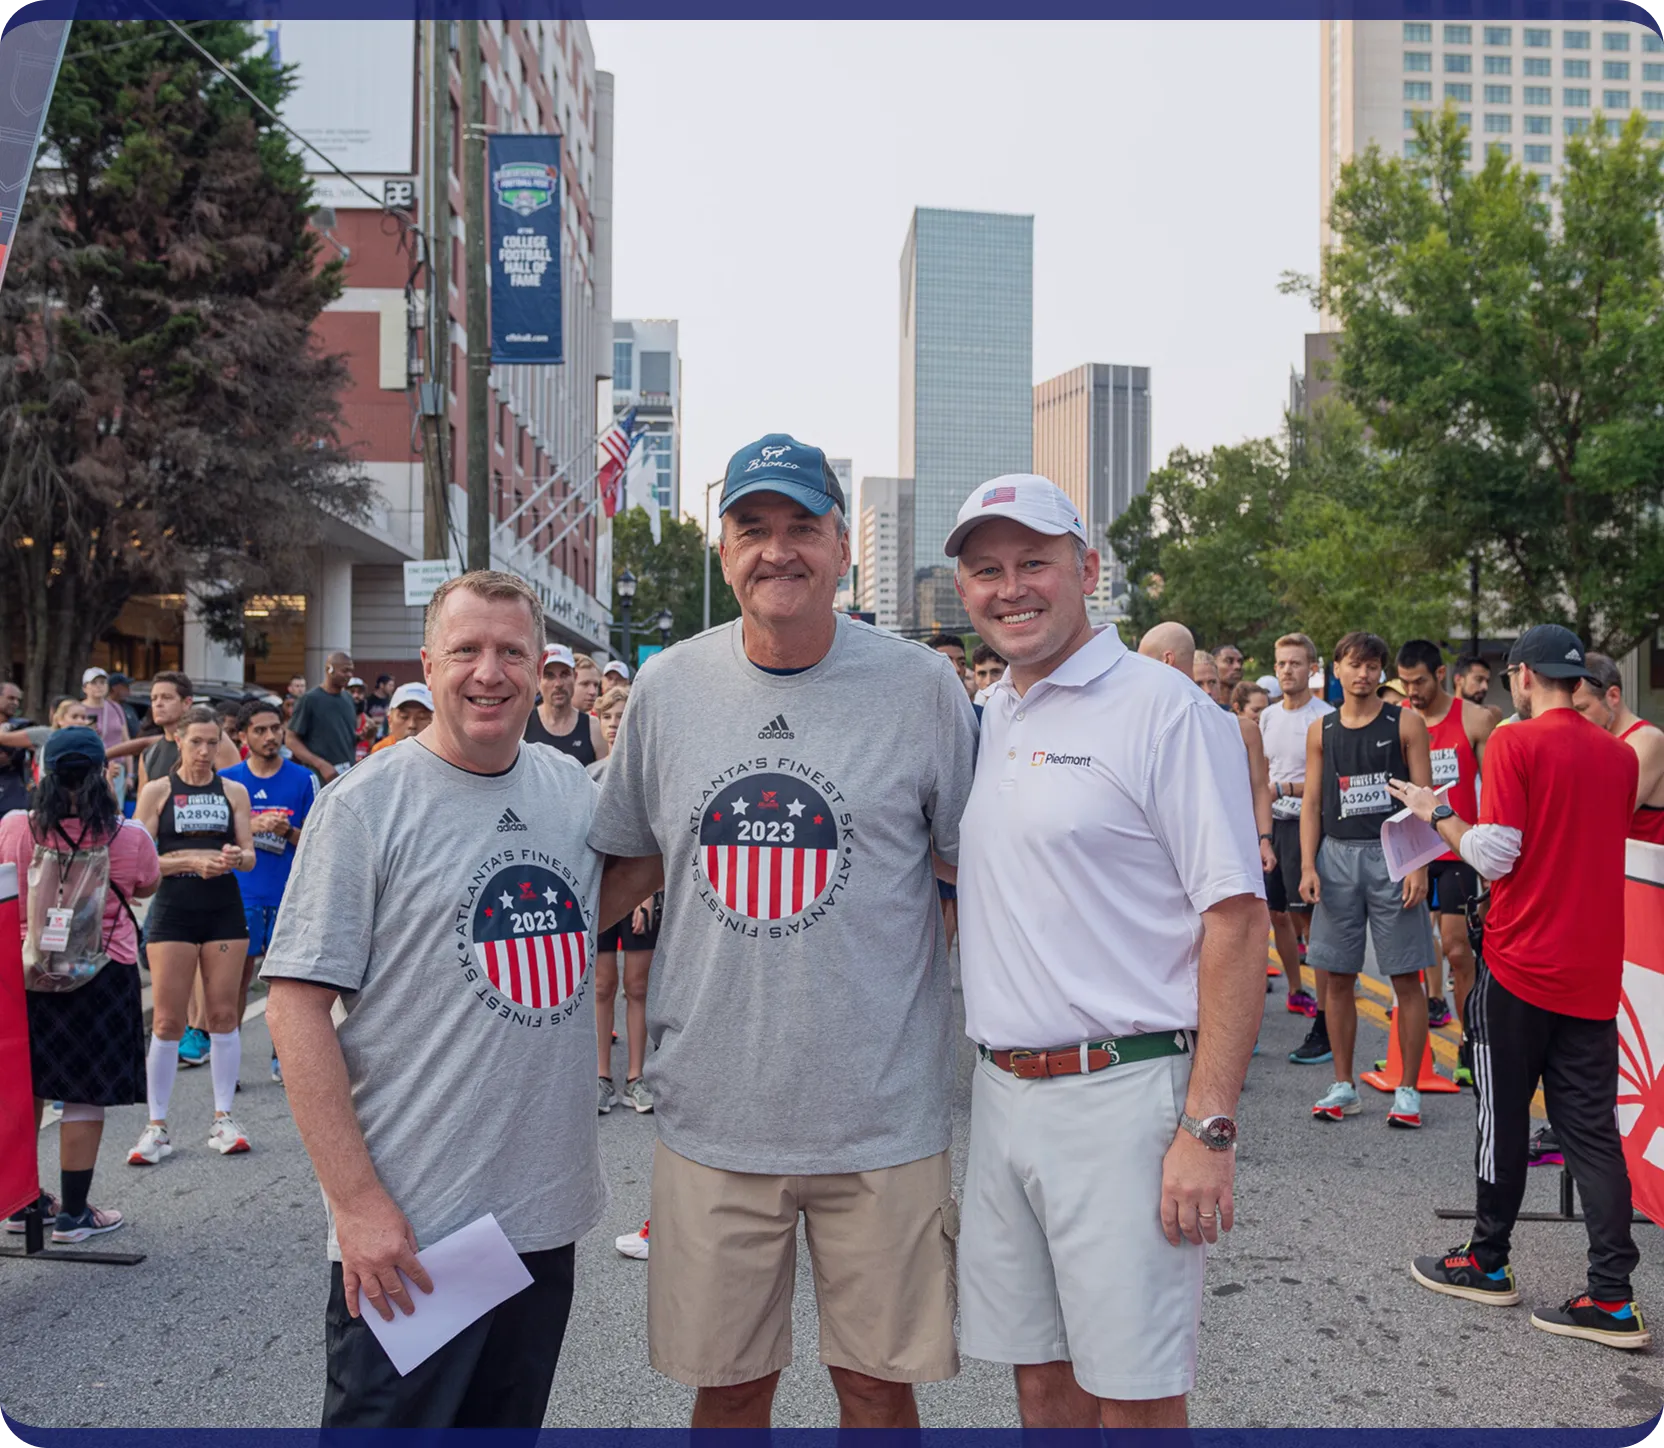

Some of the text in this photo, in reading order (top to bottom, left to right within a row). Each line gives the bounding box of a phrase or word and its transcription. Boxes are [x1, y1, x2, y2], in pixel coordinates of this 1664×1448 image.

[503, 236, 548, 248] COLLEGE
[499, 248, 552, 262] FOOTBALL
[504, 261, 547, 275] HALL OF
[510, 274, 541, 287] FAME
[744, 458, 800, 472] Bronco
[758, 730, 795, 740] adidas
[1045, 753, 1091, 767] Piedmont
[1374, 772, 1387, 784] 5K
[690, 757, 854, 840] ATLANTA'S FINEST 5K
[1341, 790, 1387, 805] A32691
[176, 809, 227, 820] A28943
[496, 822, 527, 832] adidas
[737, 820, 795, 842] 2023
[456, 850, 514, 937] ATLANTA'S
[522, 849, 580, 888] FINEST
[769, 857, 852, 938] ATLANTA'S
[510, 910, 558, 933] 2023
[699, 891, 758, 938] FINEST
[458, 953, 478, 982] 5K
[475, 988, 541, 1028] FINEST
